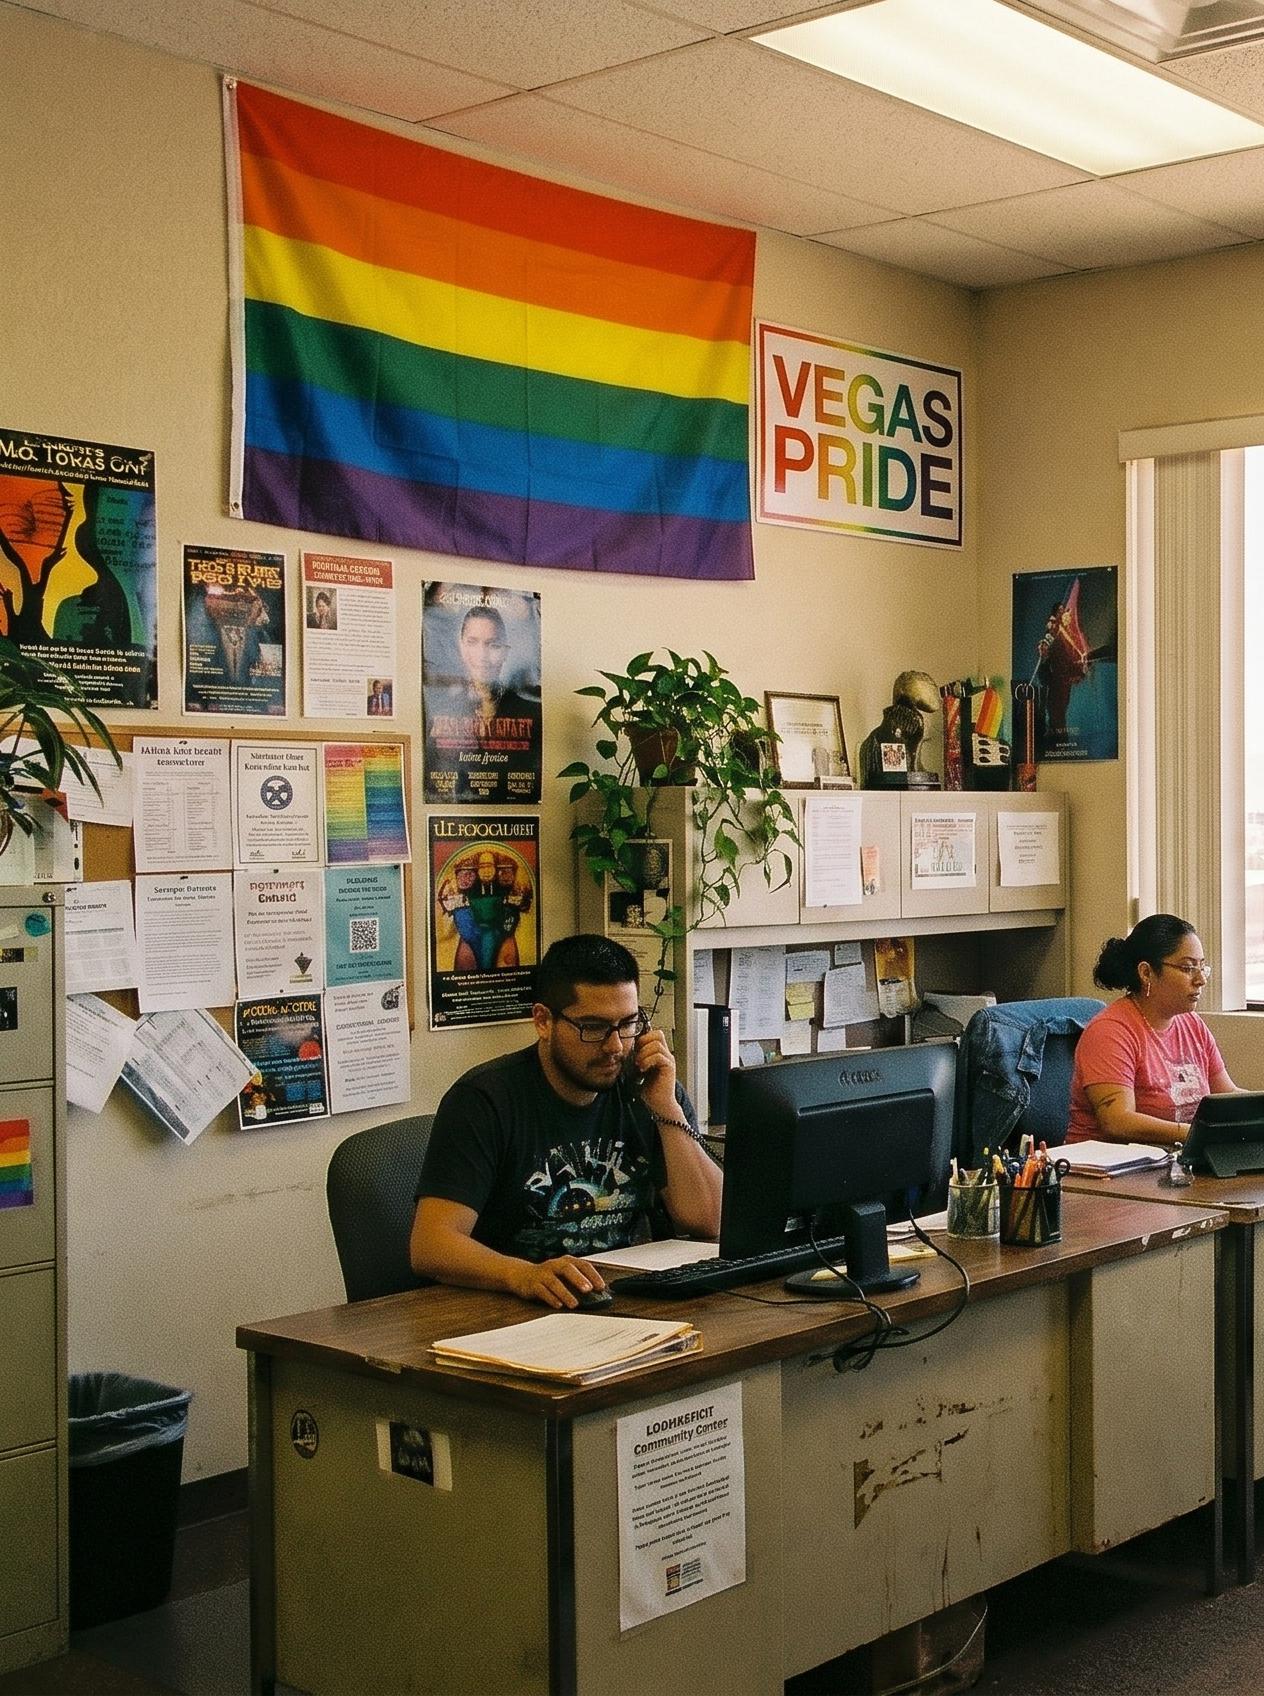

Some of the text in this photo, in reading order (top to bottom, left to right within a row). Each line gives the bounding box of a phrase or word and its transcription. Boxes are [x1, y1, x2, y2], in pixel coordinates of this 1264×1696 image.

[772, 354, 953, 448] VEGAS
[774, 424, 953, 520] PRIDE
[633, 1418, 728, 1455] Community Center
